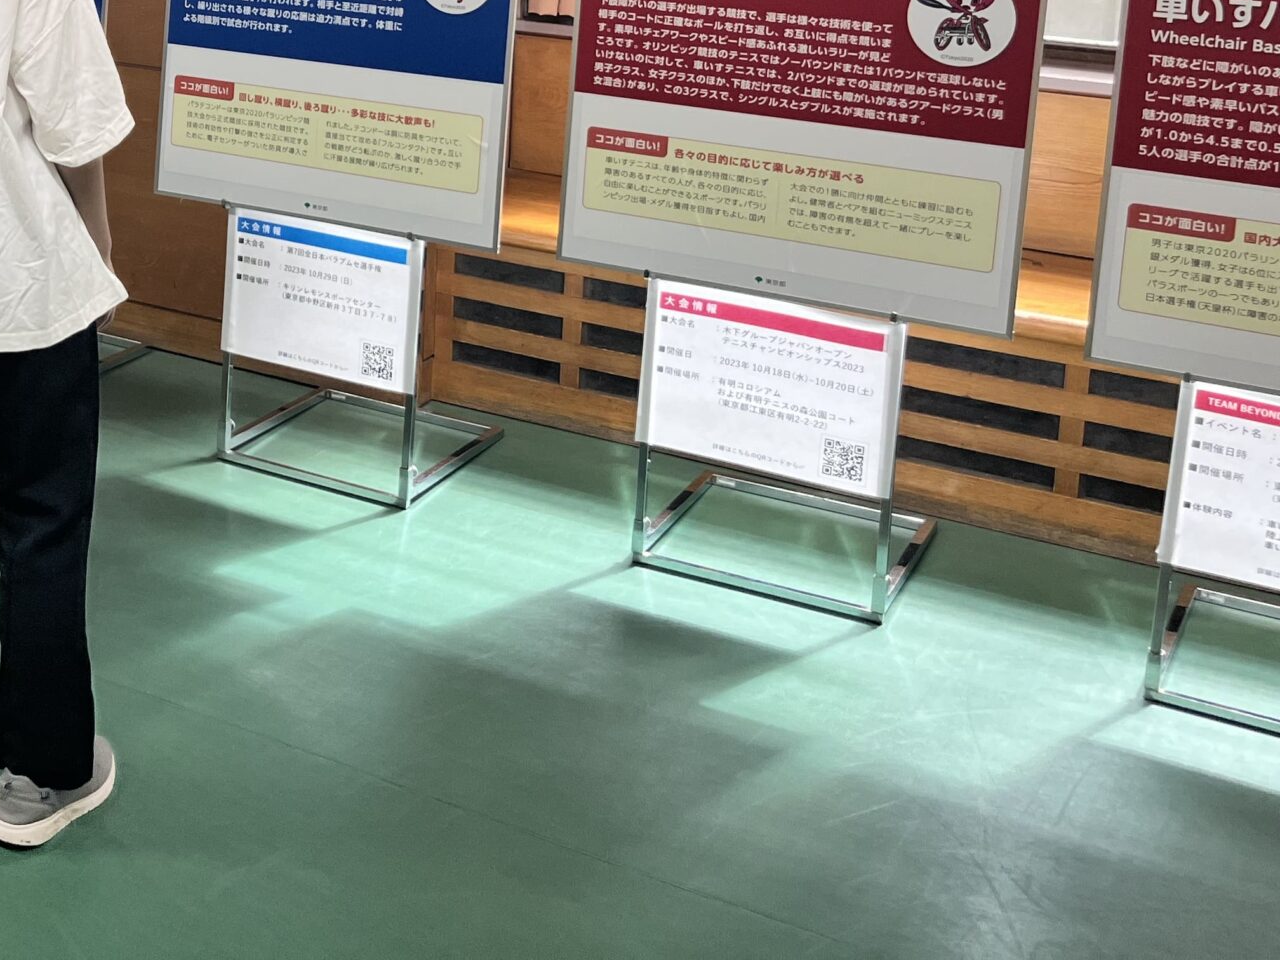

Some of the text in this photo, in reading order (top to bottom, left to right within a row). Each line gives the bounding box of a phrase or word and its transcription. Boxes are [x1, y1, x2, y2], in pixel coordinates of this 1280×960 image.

[598, 8, 892, 48] 相手のコートに正確なボールを打ち返し、お互いに得点を競いま
[1150, 29, 1247, 51] Wheelchair
[1147, 72, 1280, 98] しながらプレイする車
[1144, 91, 1279, 117] ピード感や素早いパス
[1142, 108, 1280, 135] 魅力の競技です。障が
[595, 134, 661, 151] ココが面白い!
[674, 148, 864, 184] 各々の目的に応じて楽しみ方が選べる
[1138, 144, 1279, 173] 5人の選手の合計点が1
[241, 221, 282, 236] 大会情報
[787, 219, 856, 237] むこともできます。
[1138, 212, 1226, 235] ココが面白い!
[244, 238, 265, 249] 大会名
[765, 278, 786, 288] 東京都
[1148, 266, 1280, 295] リーグで活躍する選手も出
[1147, 279, 1279, 309] パラスポーツの一つでもあり
[664, 296, 718, 314] 大会情報
[1145, 293, 1280, 322] 日本選手権(天皇杯)に障害の
[668, 315, 695, 329] 大会名
[666, 345, 692, 359] 開催日
[722, 336, 865, 374] テニスチャンピオンシップス2023
[664, 365, 700, 381] 開催場所
[1208, 396, 1237, 411] TEAM
[1206, 420, 1261, 439] イベント名
[1202, 441, 1247, 460] 開催日時
[1198, 464, 1244, 483] 開催場所
[1192, 502, 1233, 519] 体験内容
